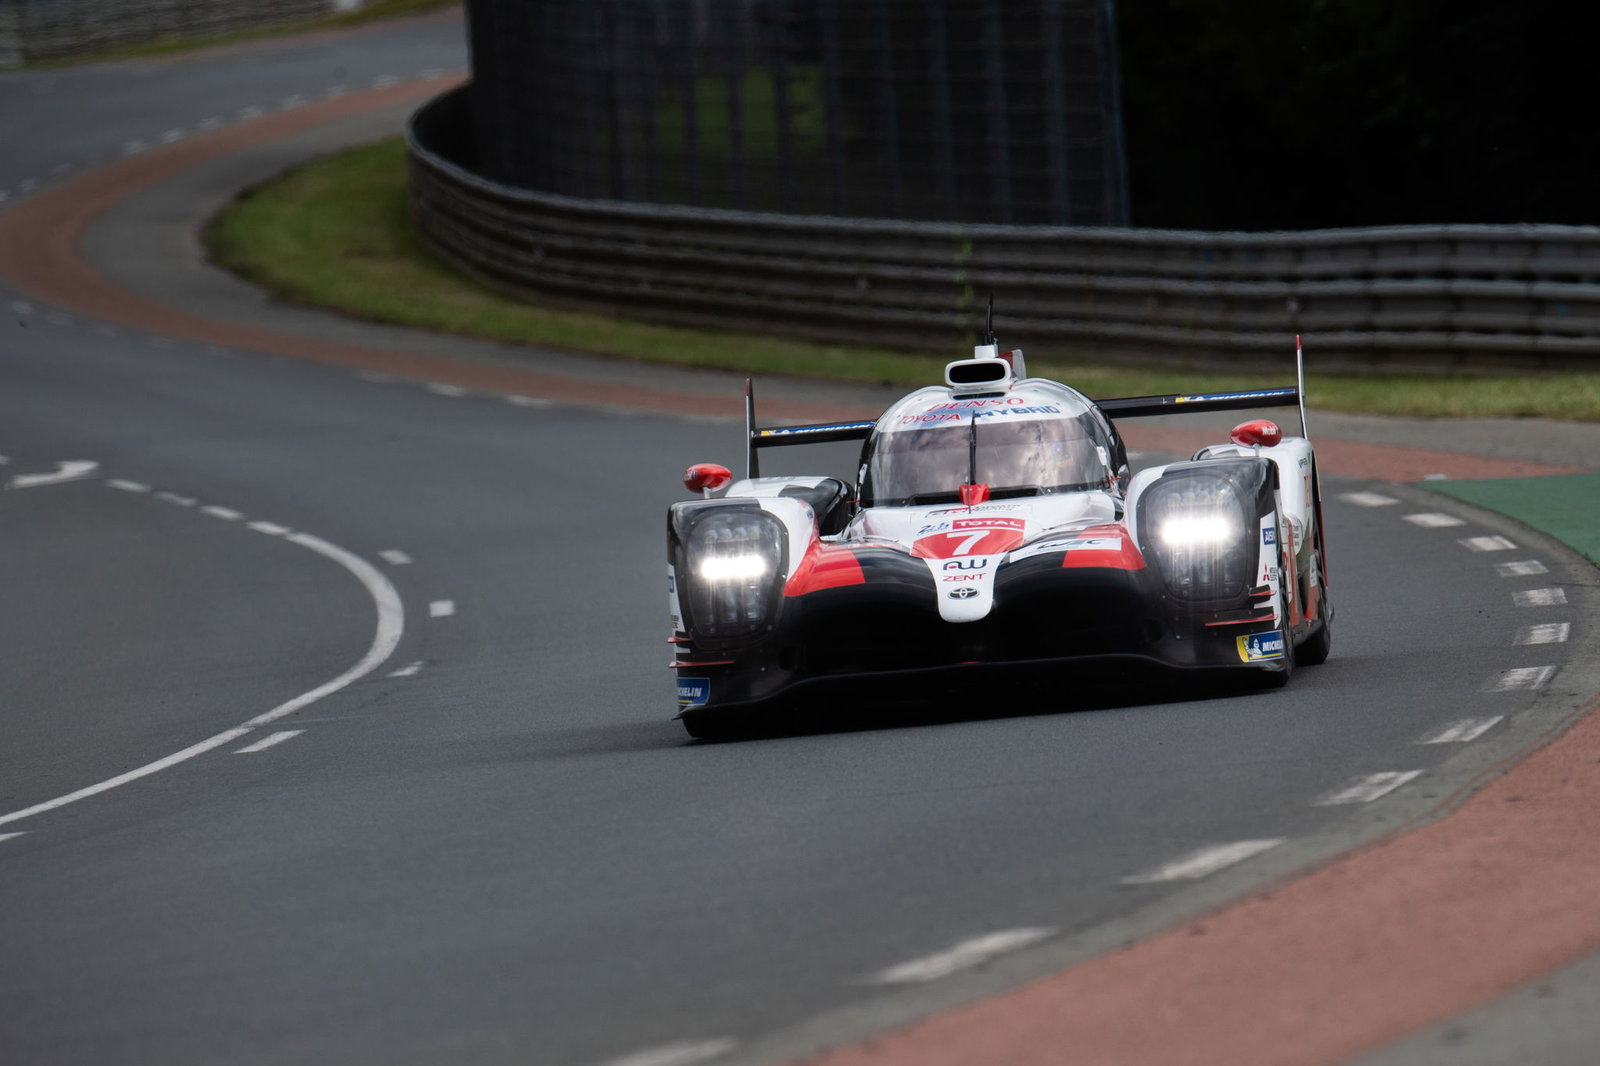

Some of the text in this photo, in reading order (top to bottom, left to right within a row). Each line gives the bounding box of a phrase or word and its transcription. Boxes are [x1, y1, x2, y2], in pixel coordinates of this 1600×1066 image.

[927, 398, 1024, 412] DENSO
[898, 405, 1061, 425] TOYOTA HYBRID
[956, 520, 1022, 531] TOTAL
[946, 530, 991, 556] 7
[942, 572, 987, 582] ZENT
